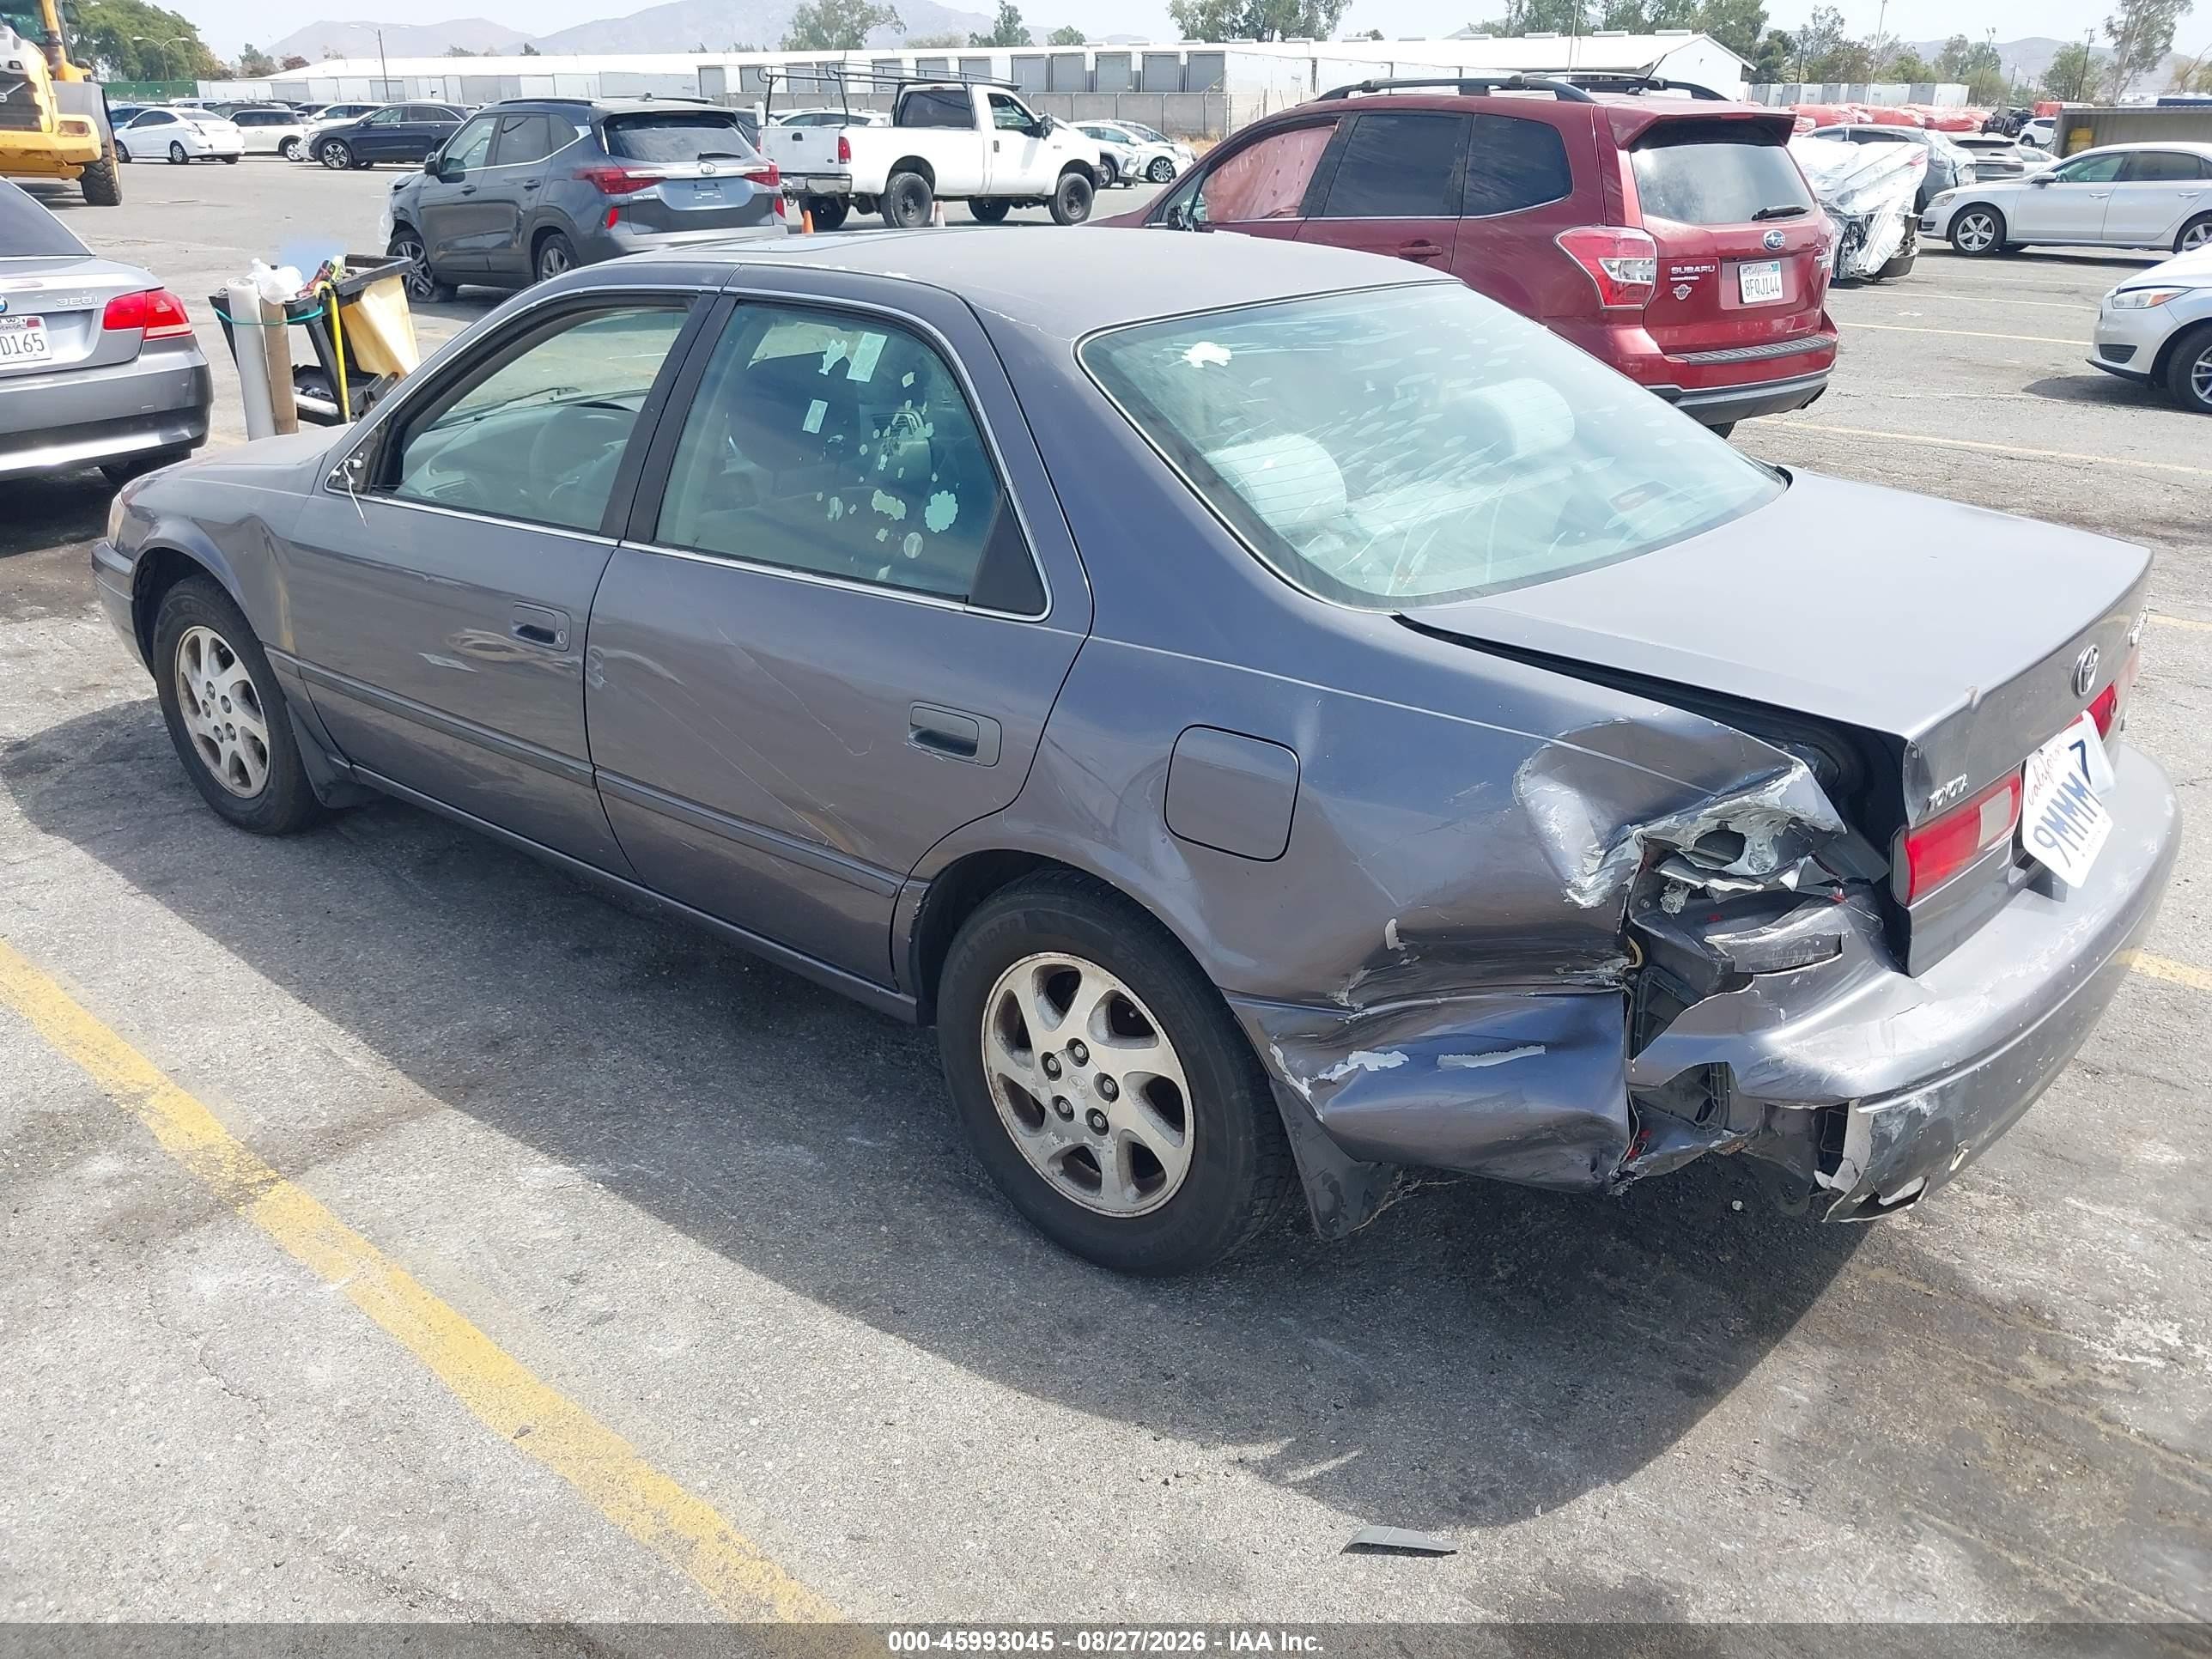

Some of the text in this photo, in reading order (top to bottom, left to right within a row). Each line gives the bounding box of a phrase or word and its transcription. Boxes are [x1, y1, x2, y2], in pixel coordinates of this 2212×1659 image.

[1671, 264, 1716, 274] SUBARU
[1745, 276, 1780, 296] 8FQJ144
[0, 332, 45, 355] D165
[1928, 773, 1968, 811] TOYOTA
